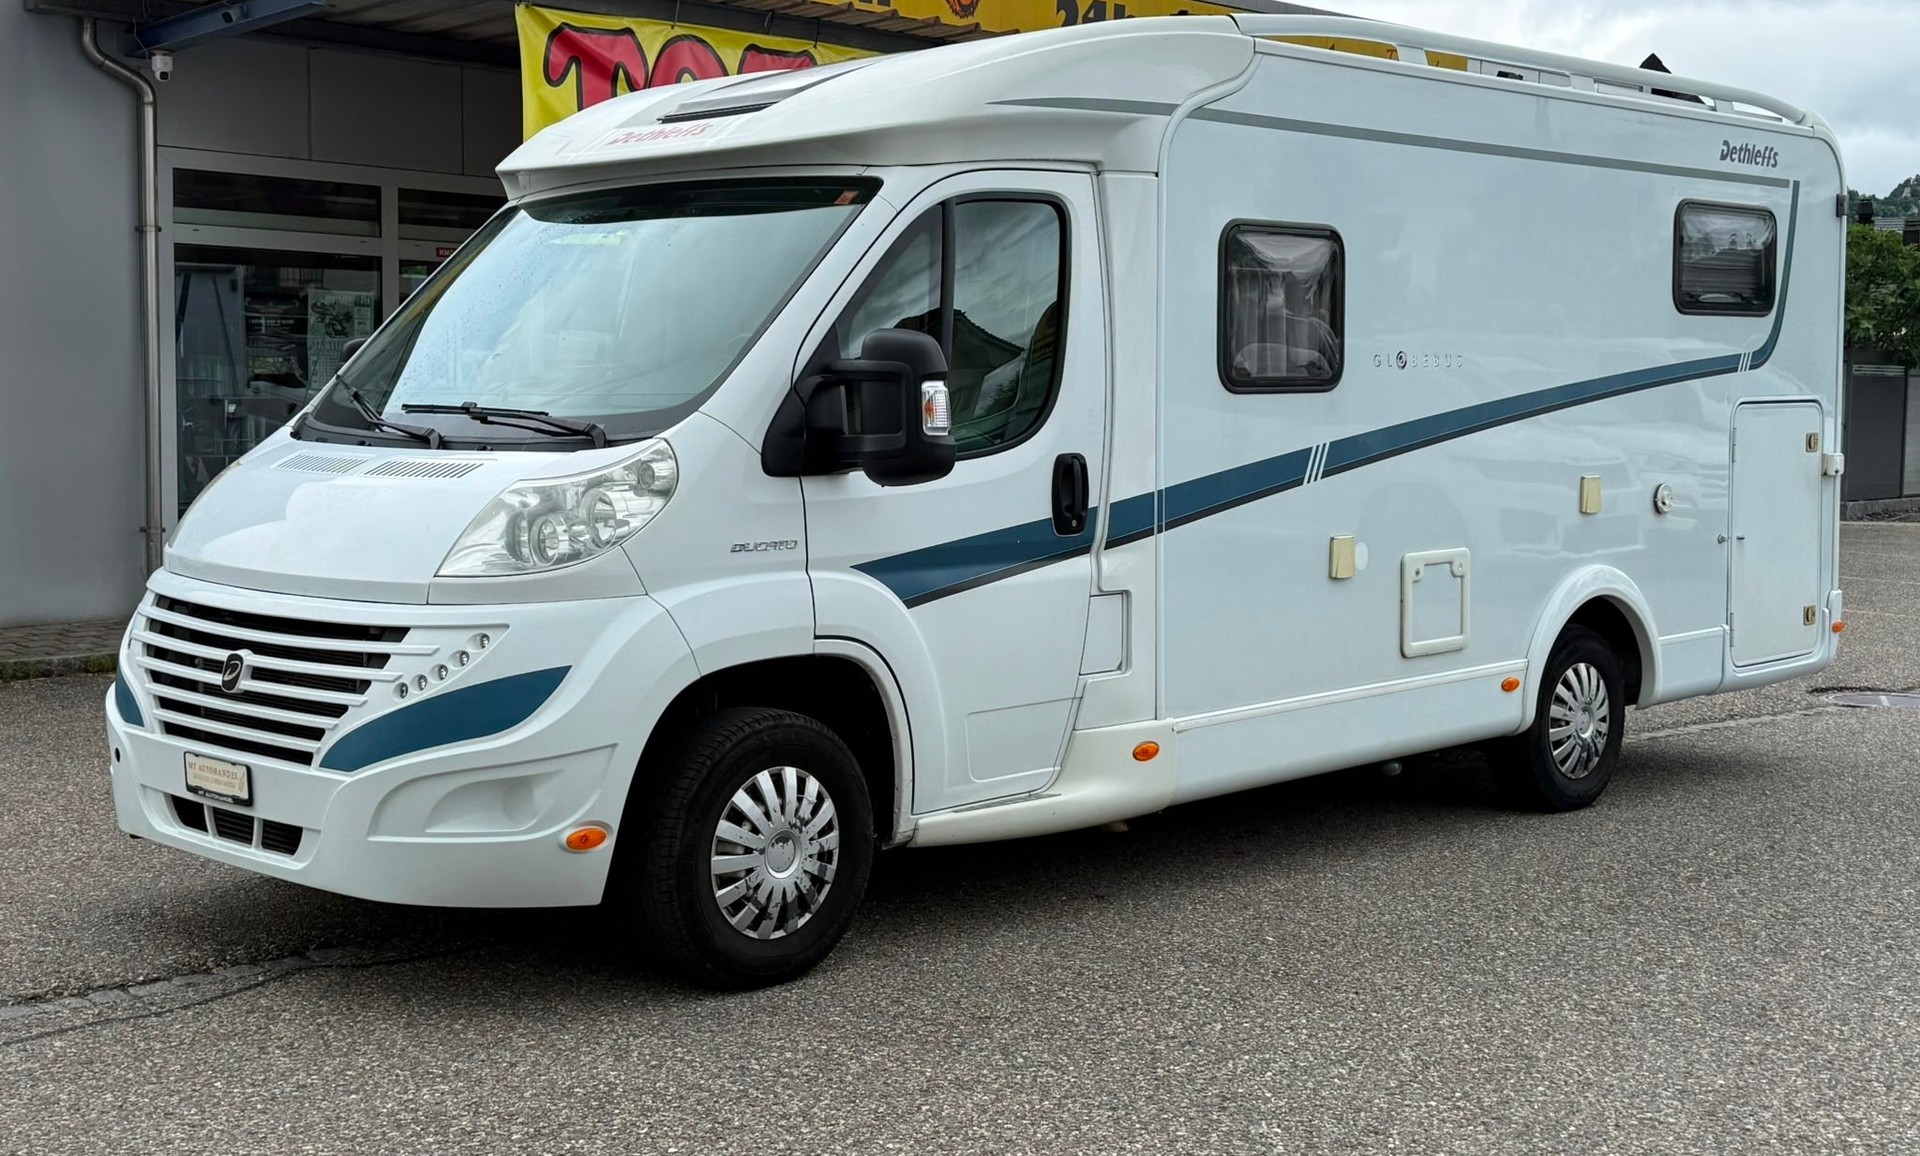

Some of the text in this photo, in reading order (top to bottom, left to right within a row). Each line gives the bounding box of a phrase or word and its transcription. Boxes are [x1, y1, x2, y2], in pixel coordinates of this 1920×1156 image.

[1719, 139, 1779, 168] Dethleffs
[1373, 350, 1463, 370] GLOBEBUS
[730, 540, 798, 553] DUCATO
